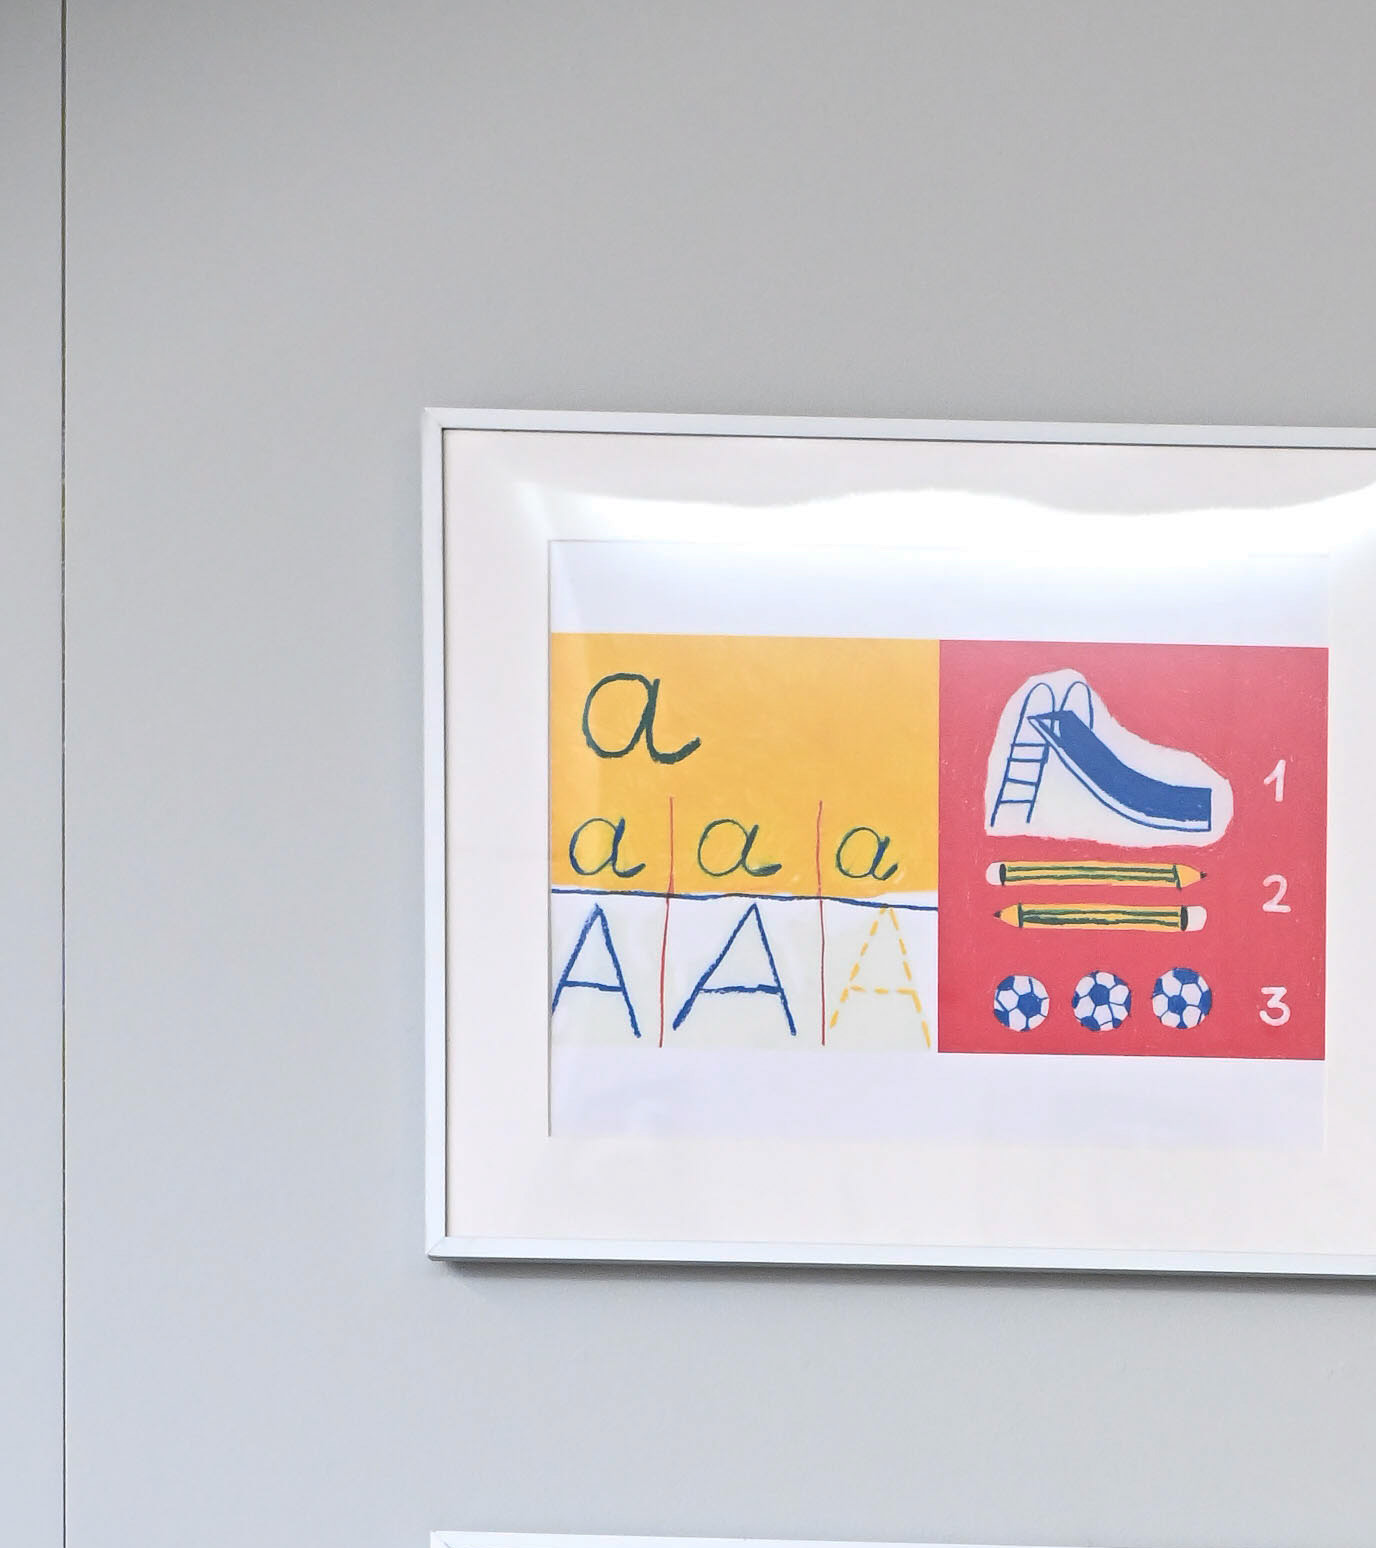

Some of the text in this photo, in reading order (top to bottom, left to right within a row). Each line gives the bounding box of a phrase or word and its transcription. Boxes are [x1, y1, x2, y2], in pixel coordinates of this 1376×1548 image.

[582, 672, 701, 764] a
[1263, 759, 1286, 802] 1
[569, 817, 898, 881] a a a
[1262, 874, 1291, 913] 2
[552, 903, 932, 1048] A A A
[1259, 986, 1291, 1027] 3
